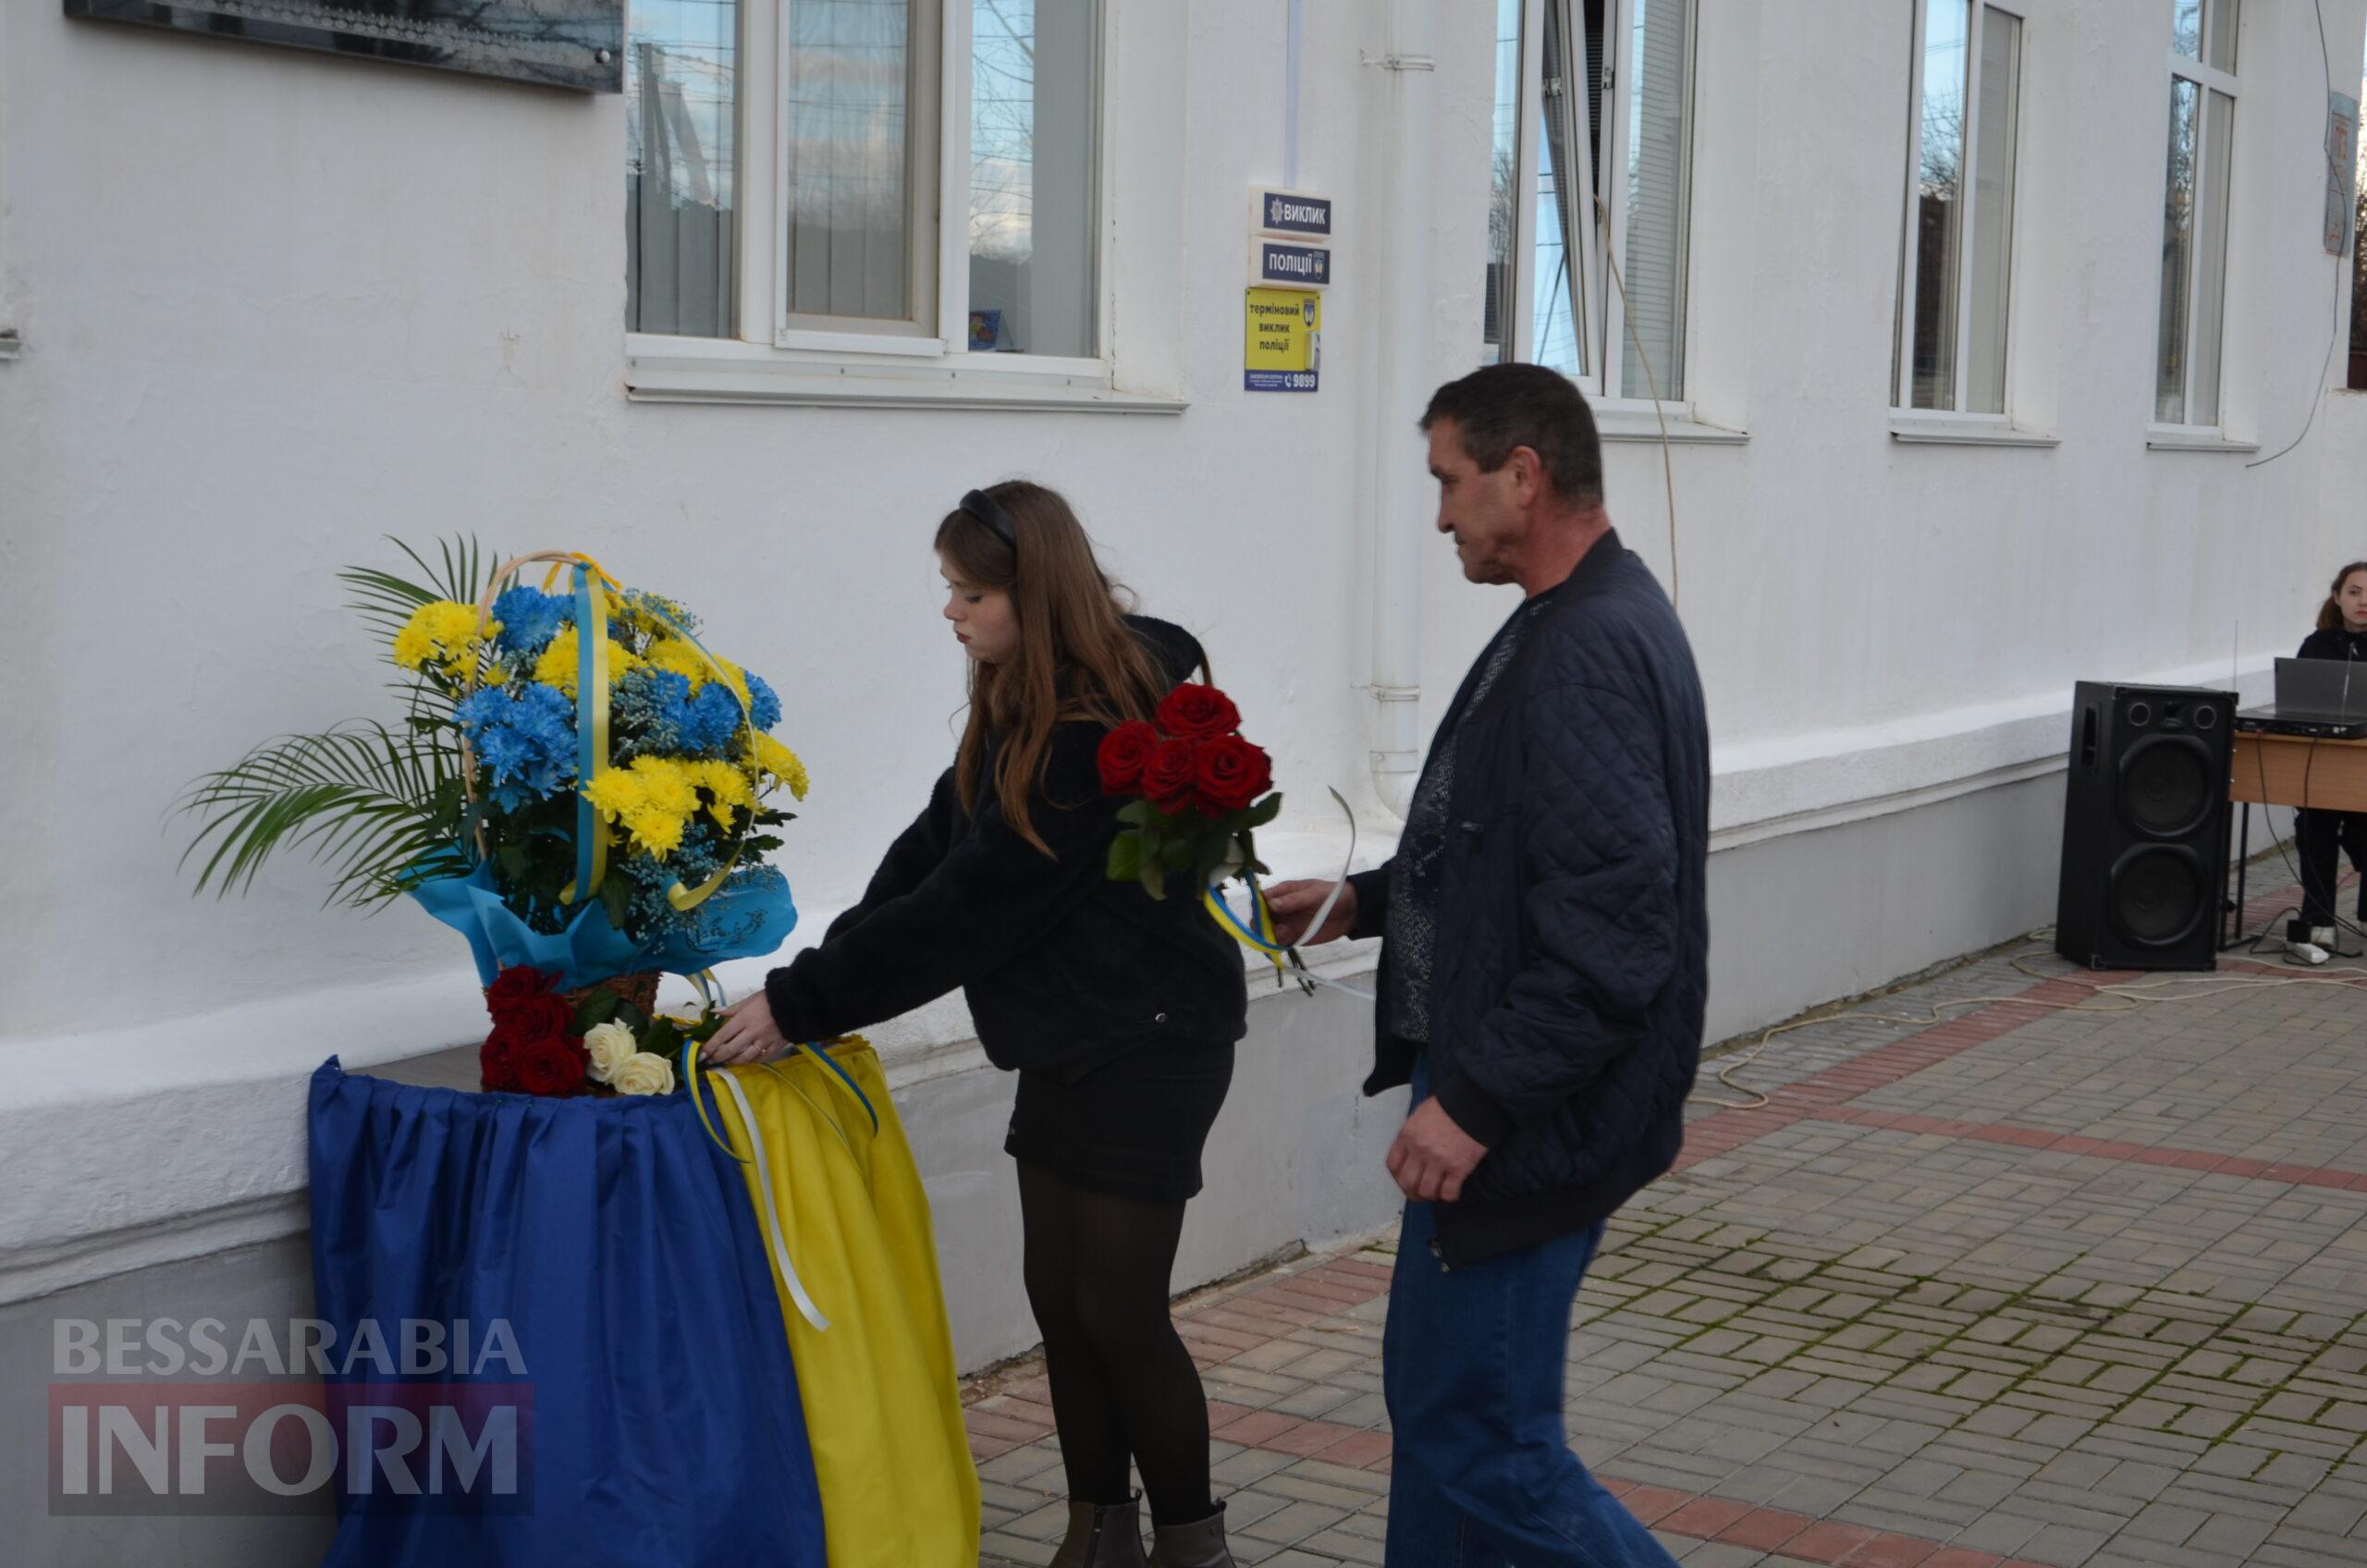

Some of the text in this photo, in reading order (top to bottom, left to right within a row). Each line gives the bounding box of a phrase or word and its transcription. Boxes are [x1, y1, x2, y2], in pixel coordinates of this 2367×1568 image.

[1283, 203, 1326, 225] ВИКЛИК
[1269, 253, 1313, 276] ПОЛІЦІЇ
[1249, 302, 1300, 316] терміновий
[1258, 323, 1290, 334] виклик
[1259, 338, 1290, 353] поліції
[1293, 374, 1316, 388] 9899
